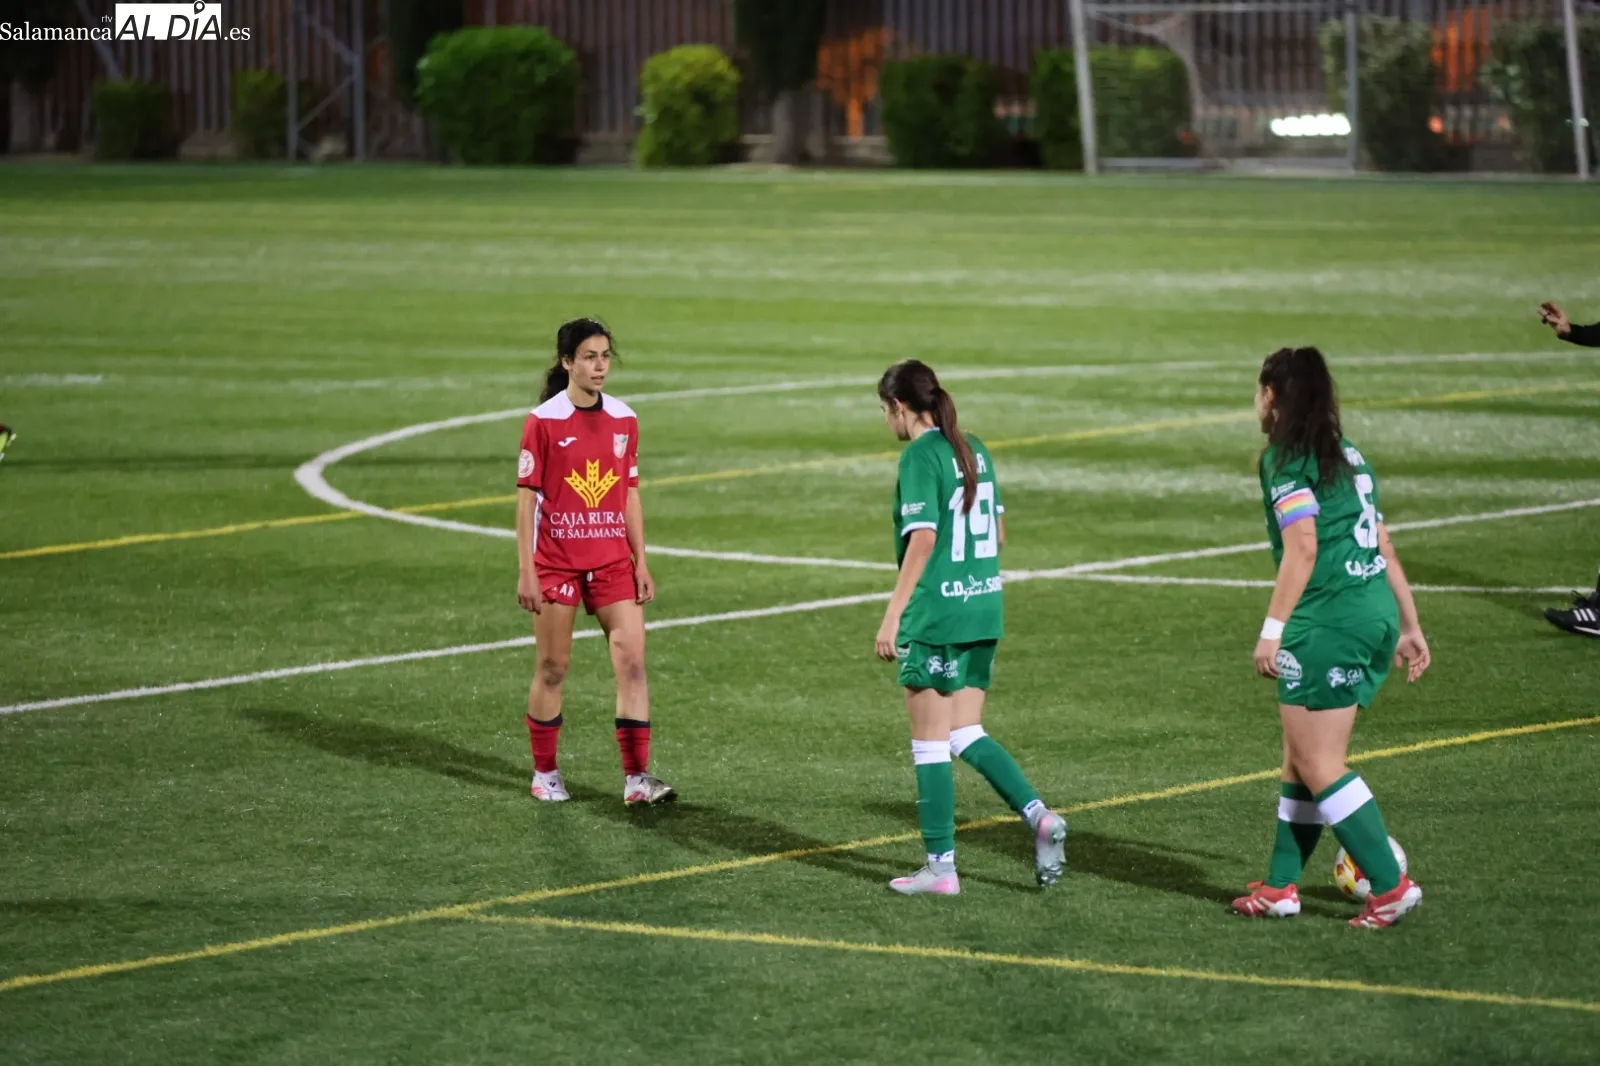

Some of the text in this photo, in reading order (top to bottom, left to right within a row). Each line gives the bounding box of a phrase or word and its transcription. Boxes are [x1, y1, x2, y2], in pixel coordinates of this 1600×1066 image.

[550, 511, 625, 529] CAJA RURA
[948, 482, 998, 562] 19
[550, 527, 626, 539] DE SALAMANC
